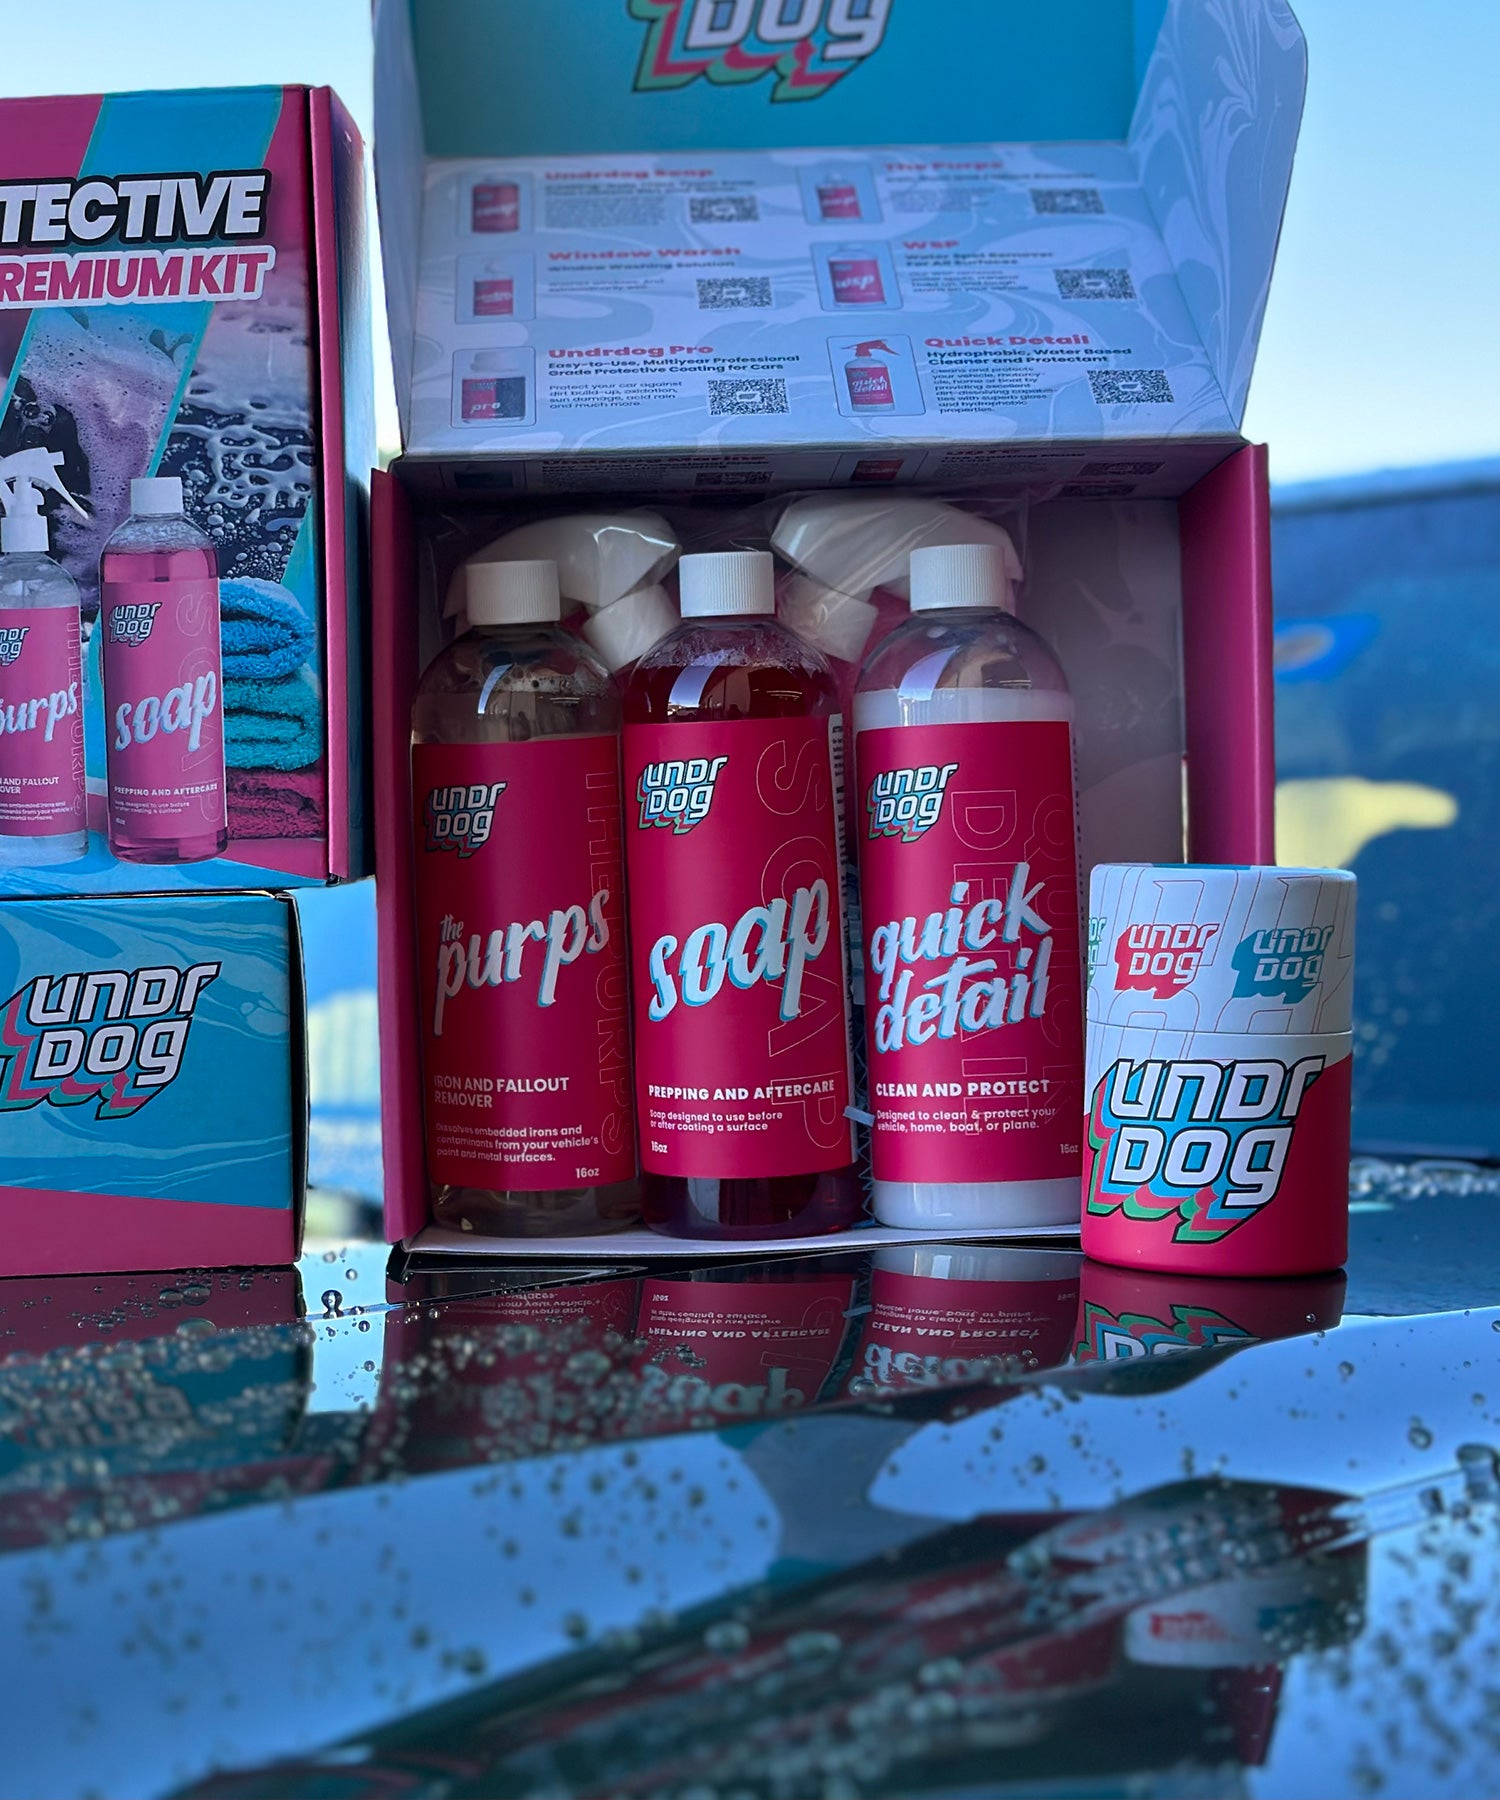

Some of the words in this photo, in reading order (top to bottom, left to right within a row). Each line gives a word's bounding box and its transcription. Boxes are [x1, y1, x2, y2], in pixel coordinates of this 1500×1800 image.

[188, 252, 268, 295] KIT
[924, 336, 1003, 348] Quick
[1009, 334, 1089, 345] Detail
[548, 346, 665, 358] Undrdog
[669, 345, 714, 355] Pro
[927, 349, 1031, 359] Hydrophobic,
[548, 360, 640, 369] Easy-to-Use,
[643, 358, 710, 367] Multiyear
[713, 355, 800, 364] Professional
[928, 358, 989, 366] Cleaner
[992, 356, 1022, 364] and
[1026, 355, 1109, 364] Protectant
[548, 368, 592, 377] Grade
[595, 366, 666, 375] Protective
[669, 364, 725, 373] Coating
[728, 363, 748, 371] for
[549, 383, 588, 391] Protect
[591, 382, 616, 390] your
[470, 402, 501, 414] pro
[114, 671, 216, 752] soap
[4, 777, 22, 786] AND
[23, 776, 59, 786] FALLOUT
[440, 914, 464, 942] the
[871, 862, 1052, 1001] quick
[648, 879, 830, 1022] soap
[434, 889, 610, 1036] purps
[875, 936, 1054, 1053] detail
[434, 1075, 461, 1091] IRON
[464, 1077, 493, 1092] AND
[496, 1077, 569, 1093] FALLOUT
[648, 1084, 709, 1100] PREPPING
[713, 1087, 749, 1100] AND
[753, 1079, 835, 1100] AFTERCARE
[875, 1083, 918, 1097] CLEAN
[921, 1083, 963, 1097] AND
[967, 1079, 1050, 1096] PROTECT
[434, 1090, 493, 1108] REMOVER
[649, 1109, 666, 1121] Soap
[667, 1110, 710, 1124] designed
[712, 1112, 723, 1122] to
[725, 1113, 745, 1122] use
[747, 1110, 783, 1121] before
[876, 1109, 915, 1123] Designed
[918, 1111, 929, 1121] to
[932, 1110, 967, 1121] clean
[970, 1110, 980, 1120] &
[984, 1108, 1029, 1122] protect
[1031, 1107, 1056, 1120] your
[474, 1125, 526, 1137] embedded
[529, 1126, 558, 1137] irons
[561, 1124, 582, 1136] and
[657, 1121, 675, 1130] after
[677, 1122, 714, 1134] coating
[716, 1123, 724, 1132] a
[726, 1121, 768, 1132] surface
[877, 1121, 909, 1133] vehicle,
[910, 1122, 946, 1133] home,
[949, 1121, 983, 1132] boat,
[986, 1122, 999, 1131] or
[1002, 1120, 1040, 1132] plane.
[495, 1139, 520, 1150] from
[522, 1141, 549, 1155] your
[650, 1140, 668, 1154] 16oz
[437, 1148, 460, 1158] paint
[461, 1149, 477, 1159] and
[478, 1151, 502, 1162] metal
[503, 1151, 556, 1163] surfaces.
[575, 1167, 600, 1179] 16oz
